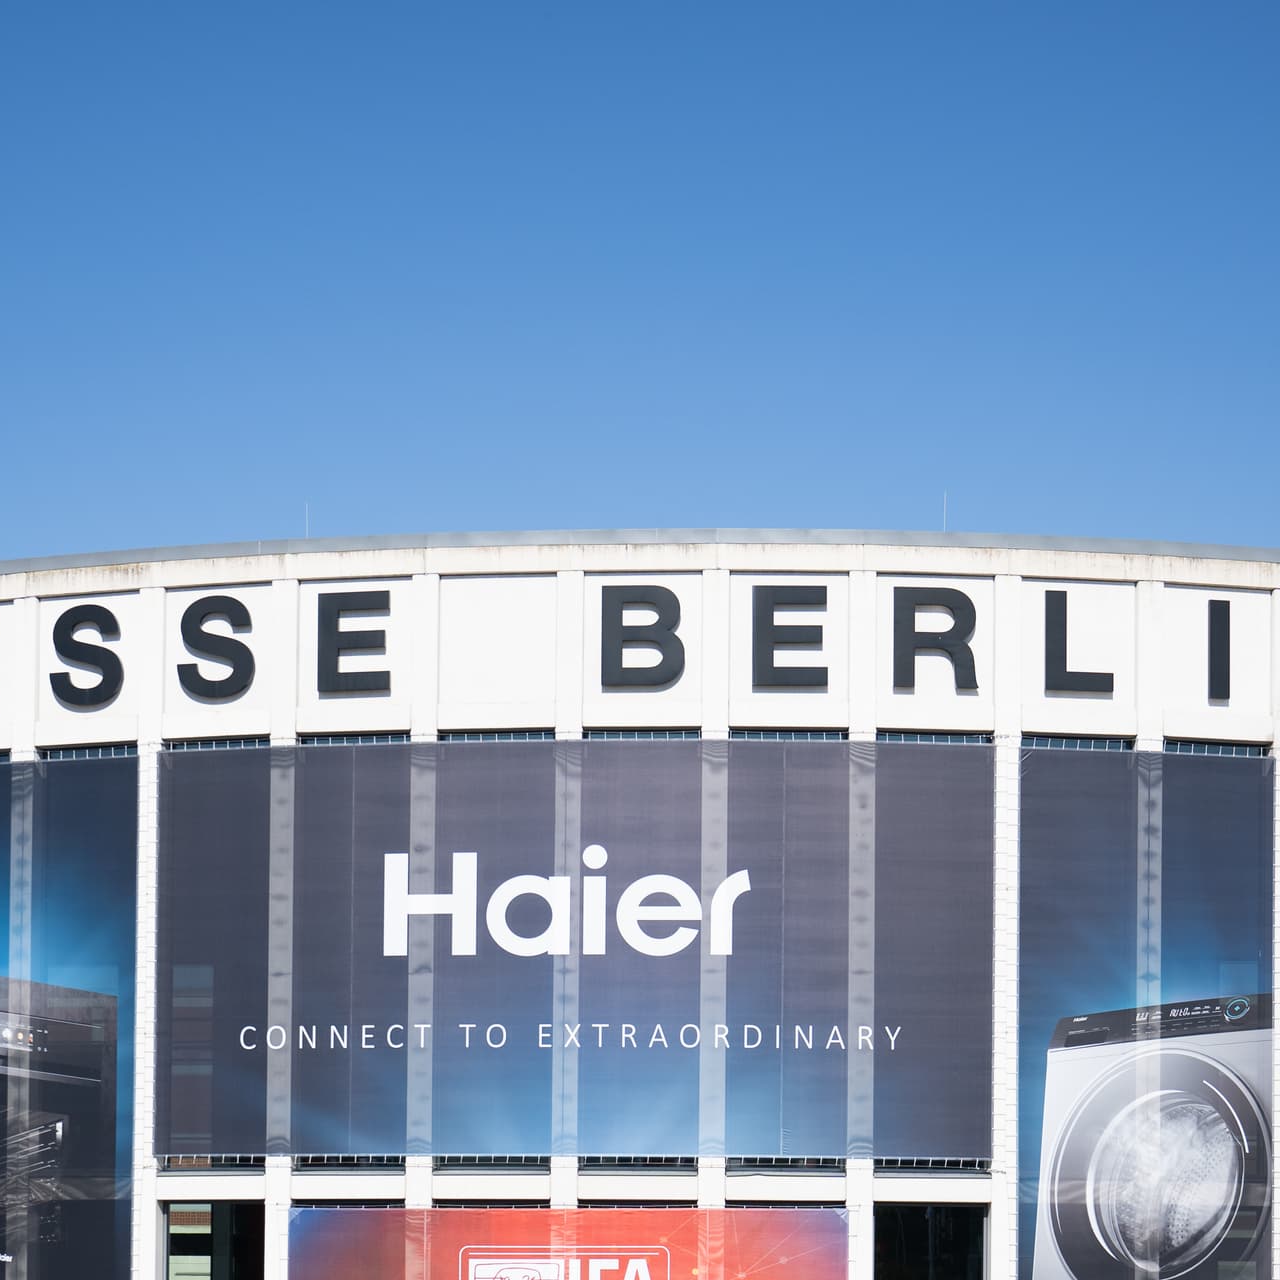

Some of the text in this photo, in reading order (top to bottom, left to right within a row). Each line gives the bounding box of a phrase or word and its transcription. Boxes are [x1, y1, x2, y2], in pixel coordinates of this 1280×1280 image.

[382, 843, 751, 957] Haier
[239, 1022, 903, 1051] CONNECT TO EXTRAORDINARY
